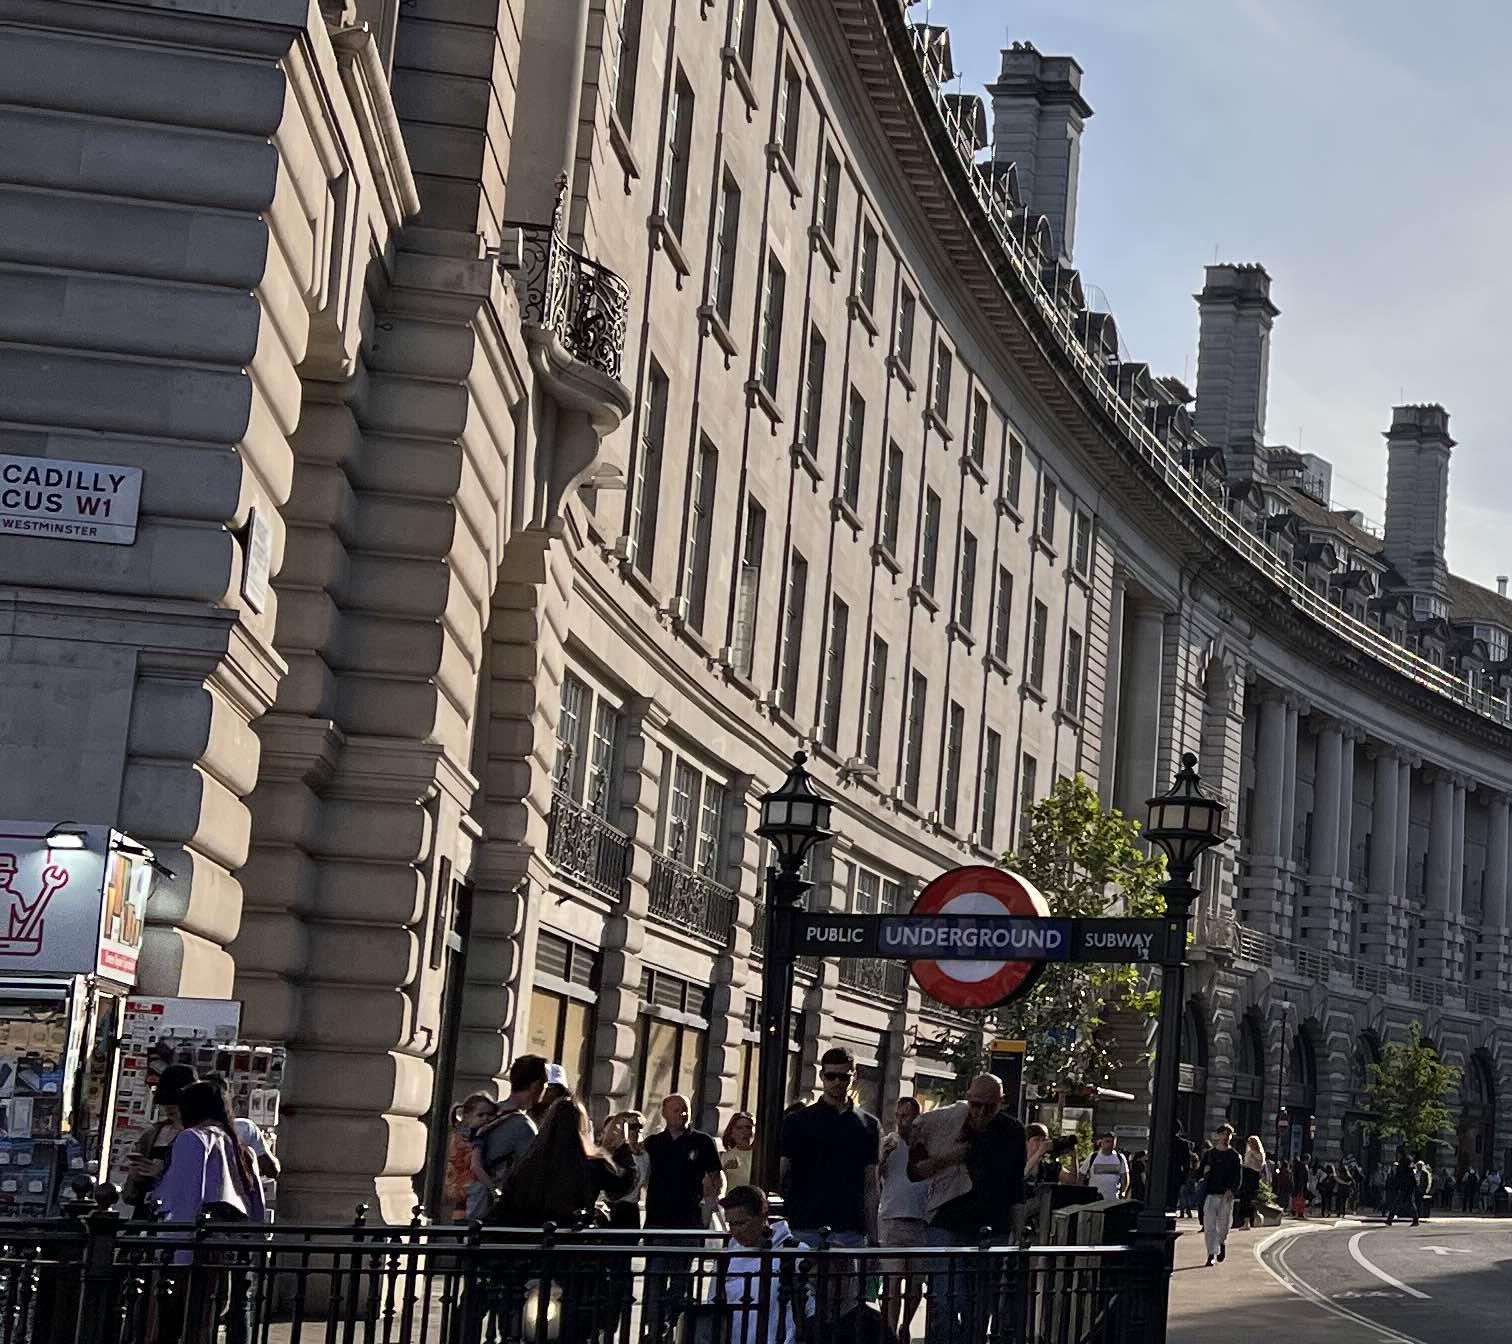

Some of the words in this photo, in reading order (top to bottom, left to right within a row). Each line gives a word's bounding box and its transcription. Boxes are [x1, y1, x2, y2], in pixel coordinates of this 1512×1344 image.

[3, 464, 126, 493] CADILLY
[2, 489, 63, 512] CUS
[76, 495, 111, 517] W1
[2, 518, 97, 536] WESTMINSTER
[806, 927, 864, 943] PUBLIC
[886, 927, 1062, 949] UNDERGROUND
[1085, 932, 1153, 948] SUBWAY
